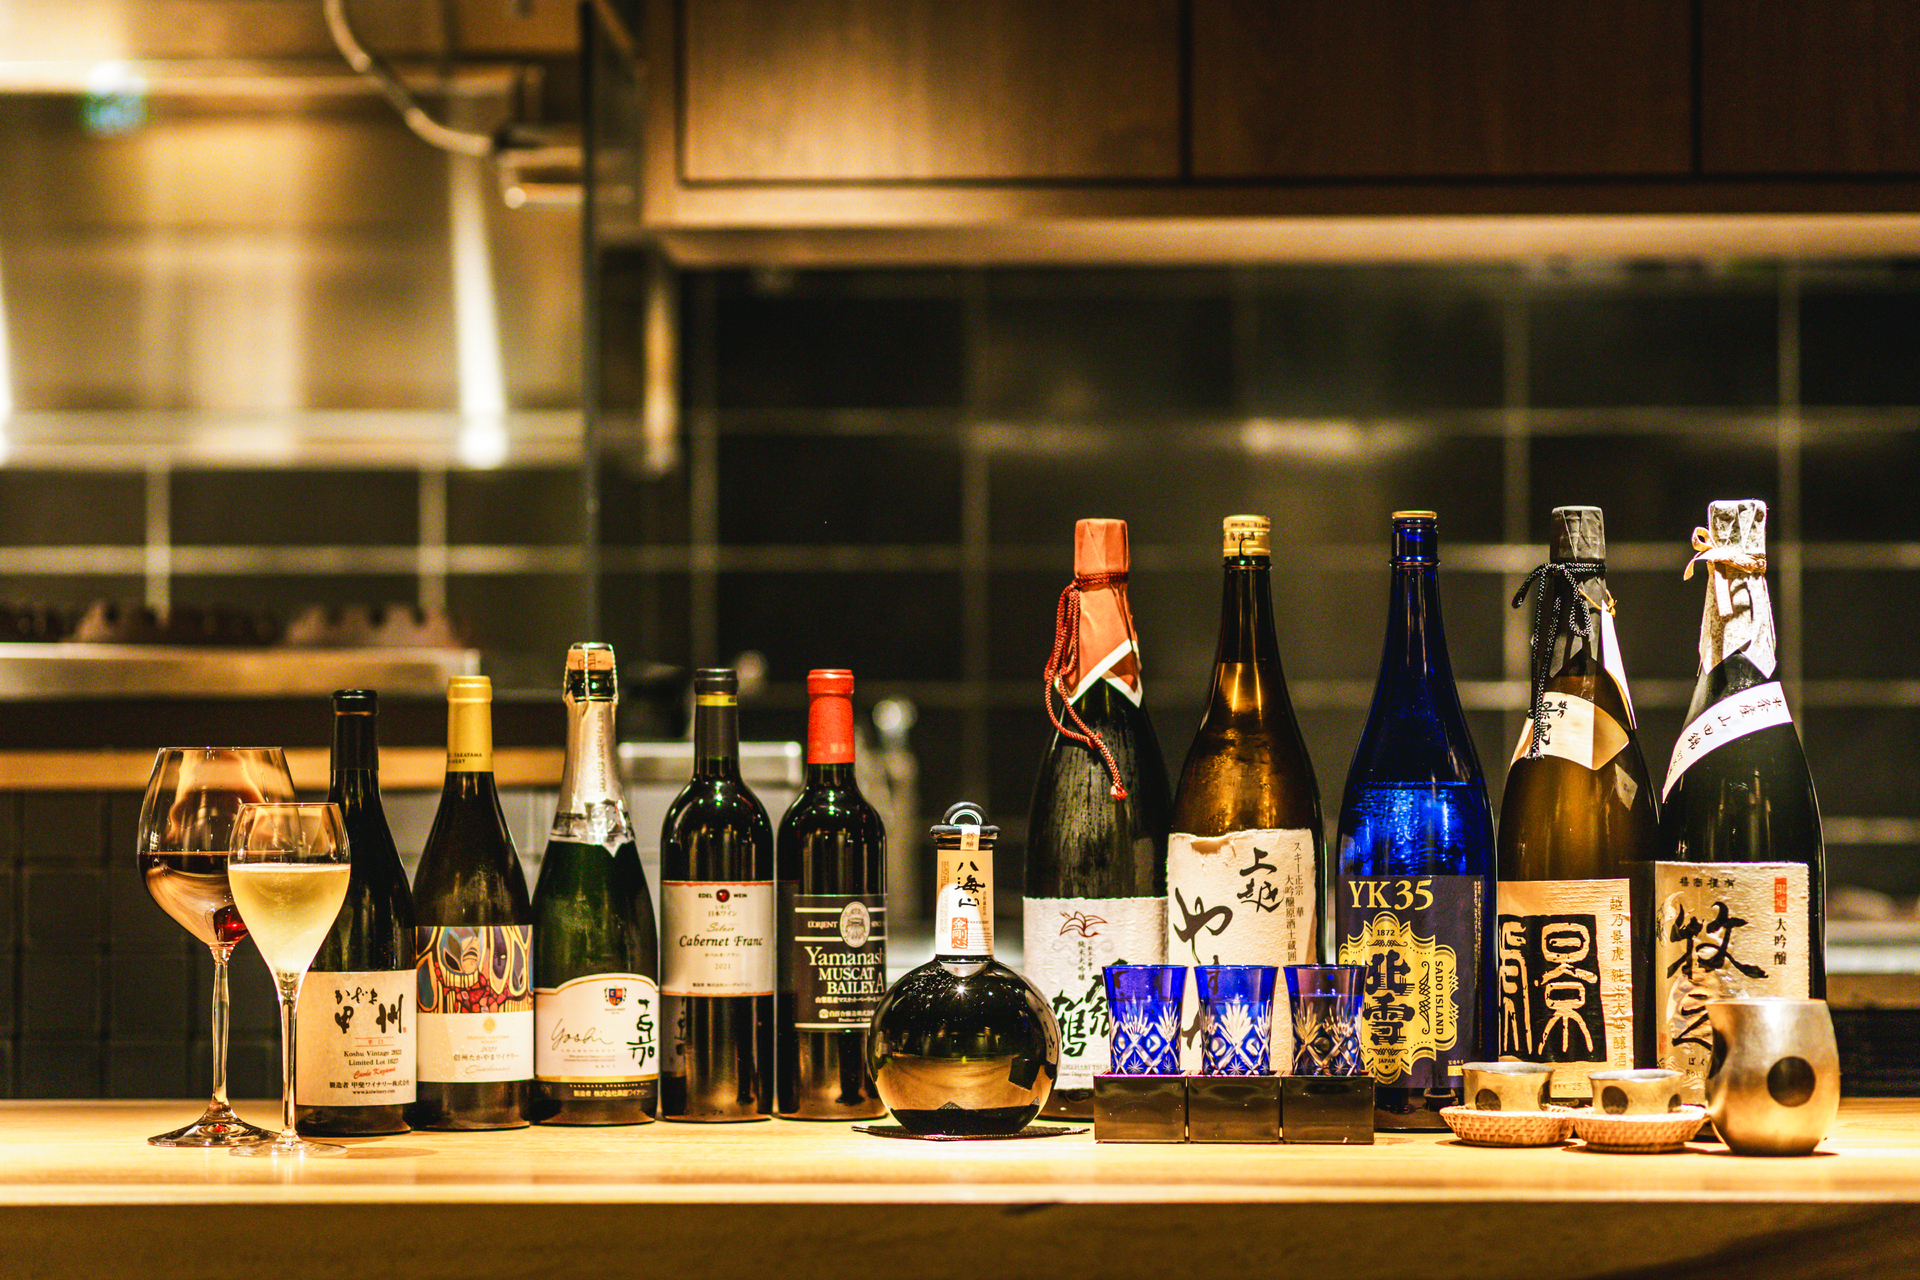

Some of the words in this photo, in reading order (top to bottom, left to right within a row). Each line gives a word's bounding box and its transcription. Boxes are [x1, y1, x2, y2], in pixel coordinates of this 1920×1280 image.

[1294, 842, 1304, 896] スキー正宗
[955, 860, 986, 908] 八海山
[680, 934, 729, 948] Cabernet
[734, 936, 763, 947] Franc
[1376, 929, 1395, 937] 1872
[1609, 897, 1624, 962] 越乃景虎
[1774, 917, 1787, 965] 大吟醸
[818, 967, 875, 981] MUSCAT
[826, 981, 877, 994] BAILEY
[876, 972, 885, 993] A
[1435, 960, 1444, 992] SADO
[1435, 993, 1444, 1035] ISLAND
[1378, 1057, 1396, 1065] JAPAN
[329, 1081, 349, 1089] 製造者
